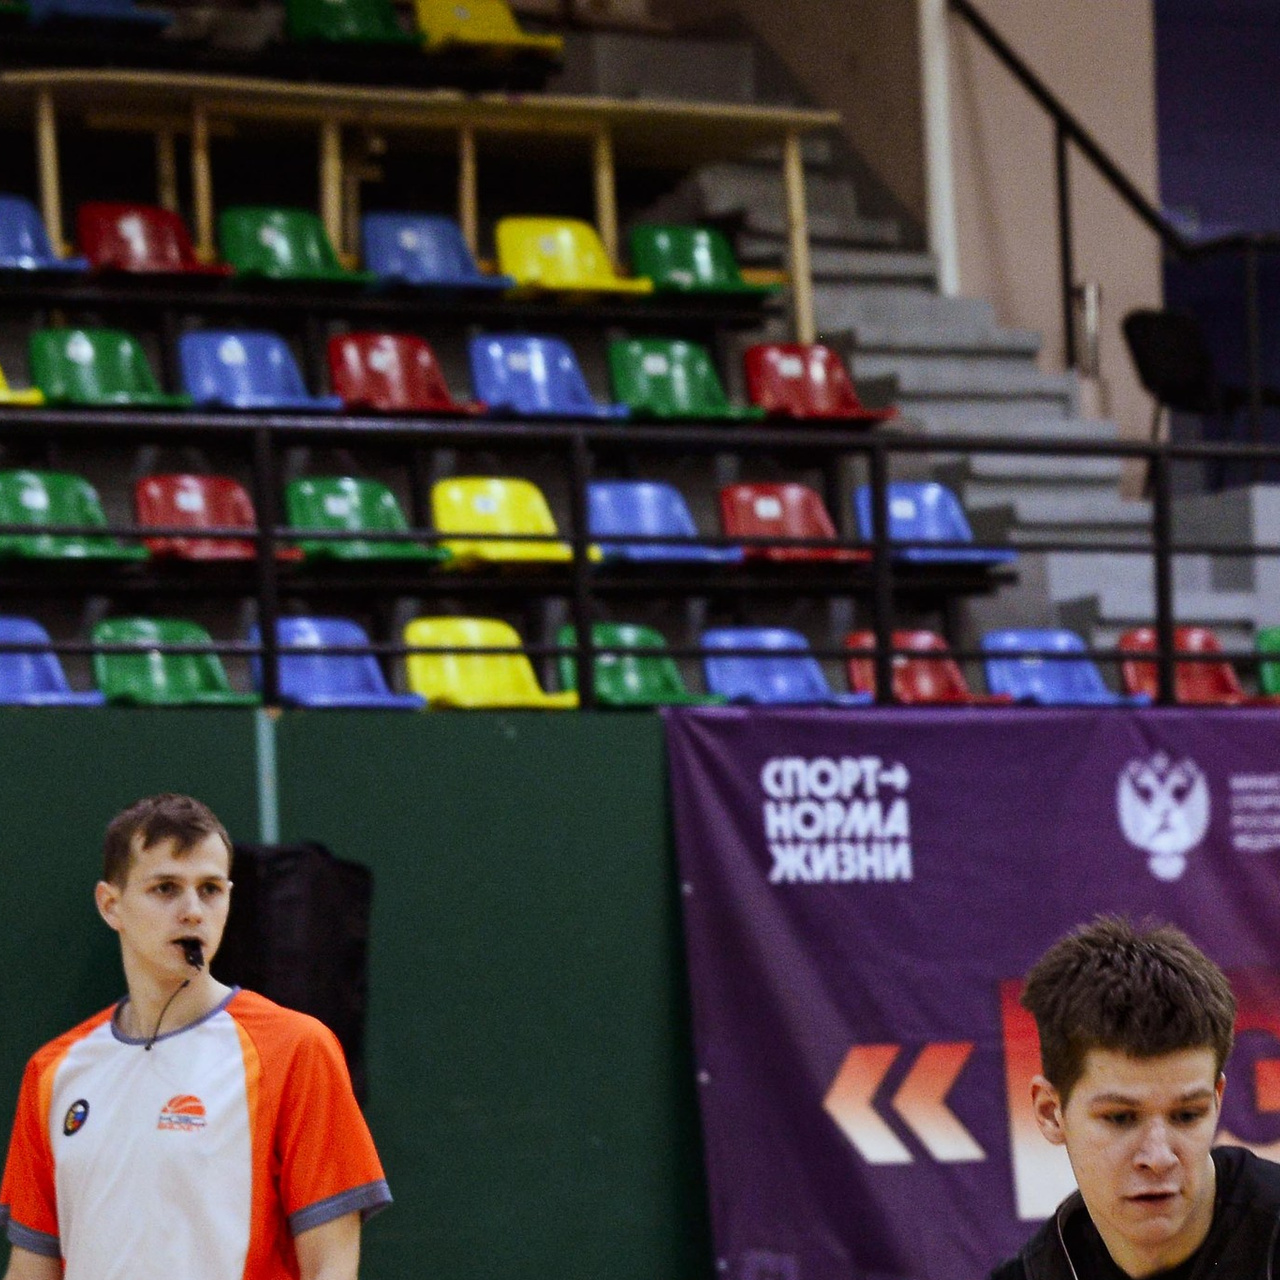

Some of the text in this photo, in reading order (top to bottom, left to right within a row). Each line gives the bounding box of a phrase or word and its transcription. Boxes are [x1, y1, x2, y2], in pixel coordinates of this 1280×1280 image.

[761, 756, 881, 800] СПОРТ
[763, 799, 910, 840] НОРМА
[769, 841, 914, 884] ЖИЗНИ
